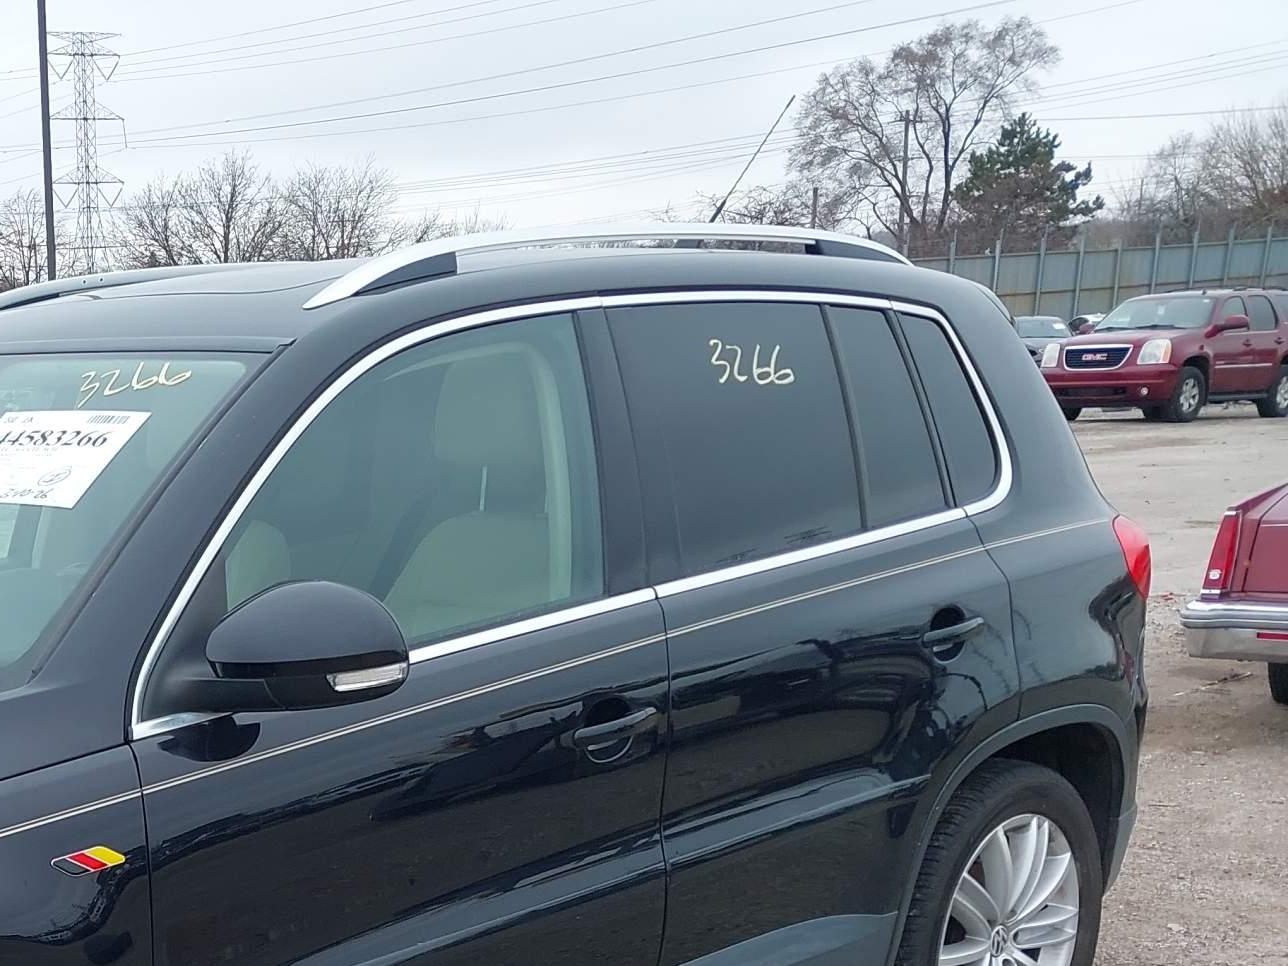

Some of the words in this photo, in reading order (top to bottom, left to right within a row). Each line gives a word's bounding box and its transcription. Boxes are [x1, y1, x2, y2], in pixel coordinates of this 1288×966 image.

[709, 338, 795, 384] 3266
[1081, 353, 1108, 361] GMC
[77, 361, 192, 409] 3266
